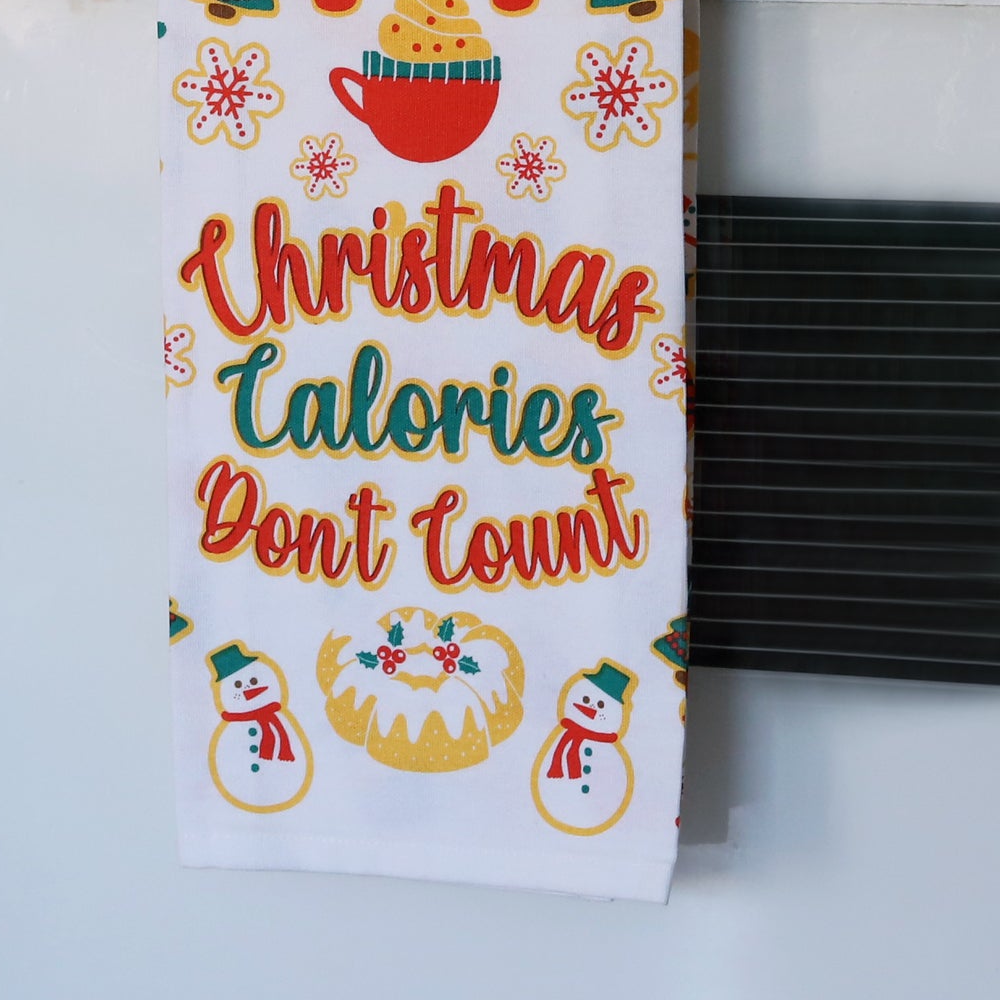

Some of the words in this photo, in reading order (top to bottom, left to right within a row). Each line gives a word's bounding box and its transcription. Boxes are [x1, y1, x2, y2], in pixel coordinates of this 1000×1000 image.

[181, 184, 657, 353] Christmas
[218, 342, 617, 466] Calories
[198, 459, 391, 584] Don't
[411, 466, 642, 587] Count
